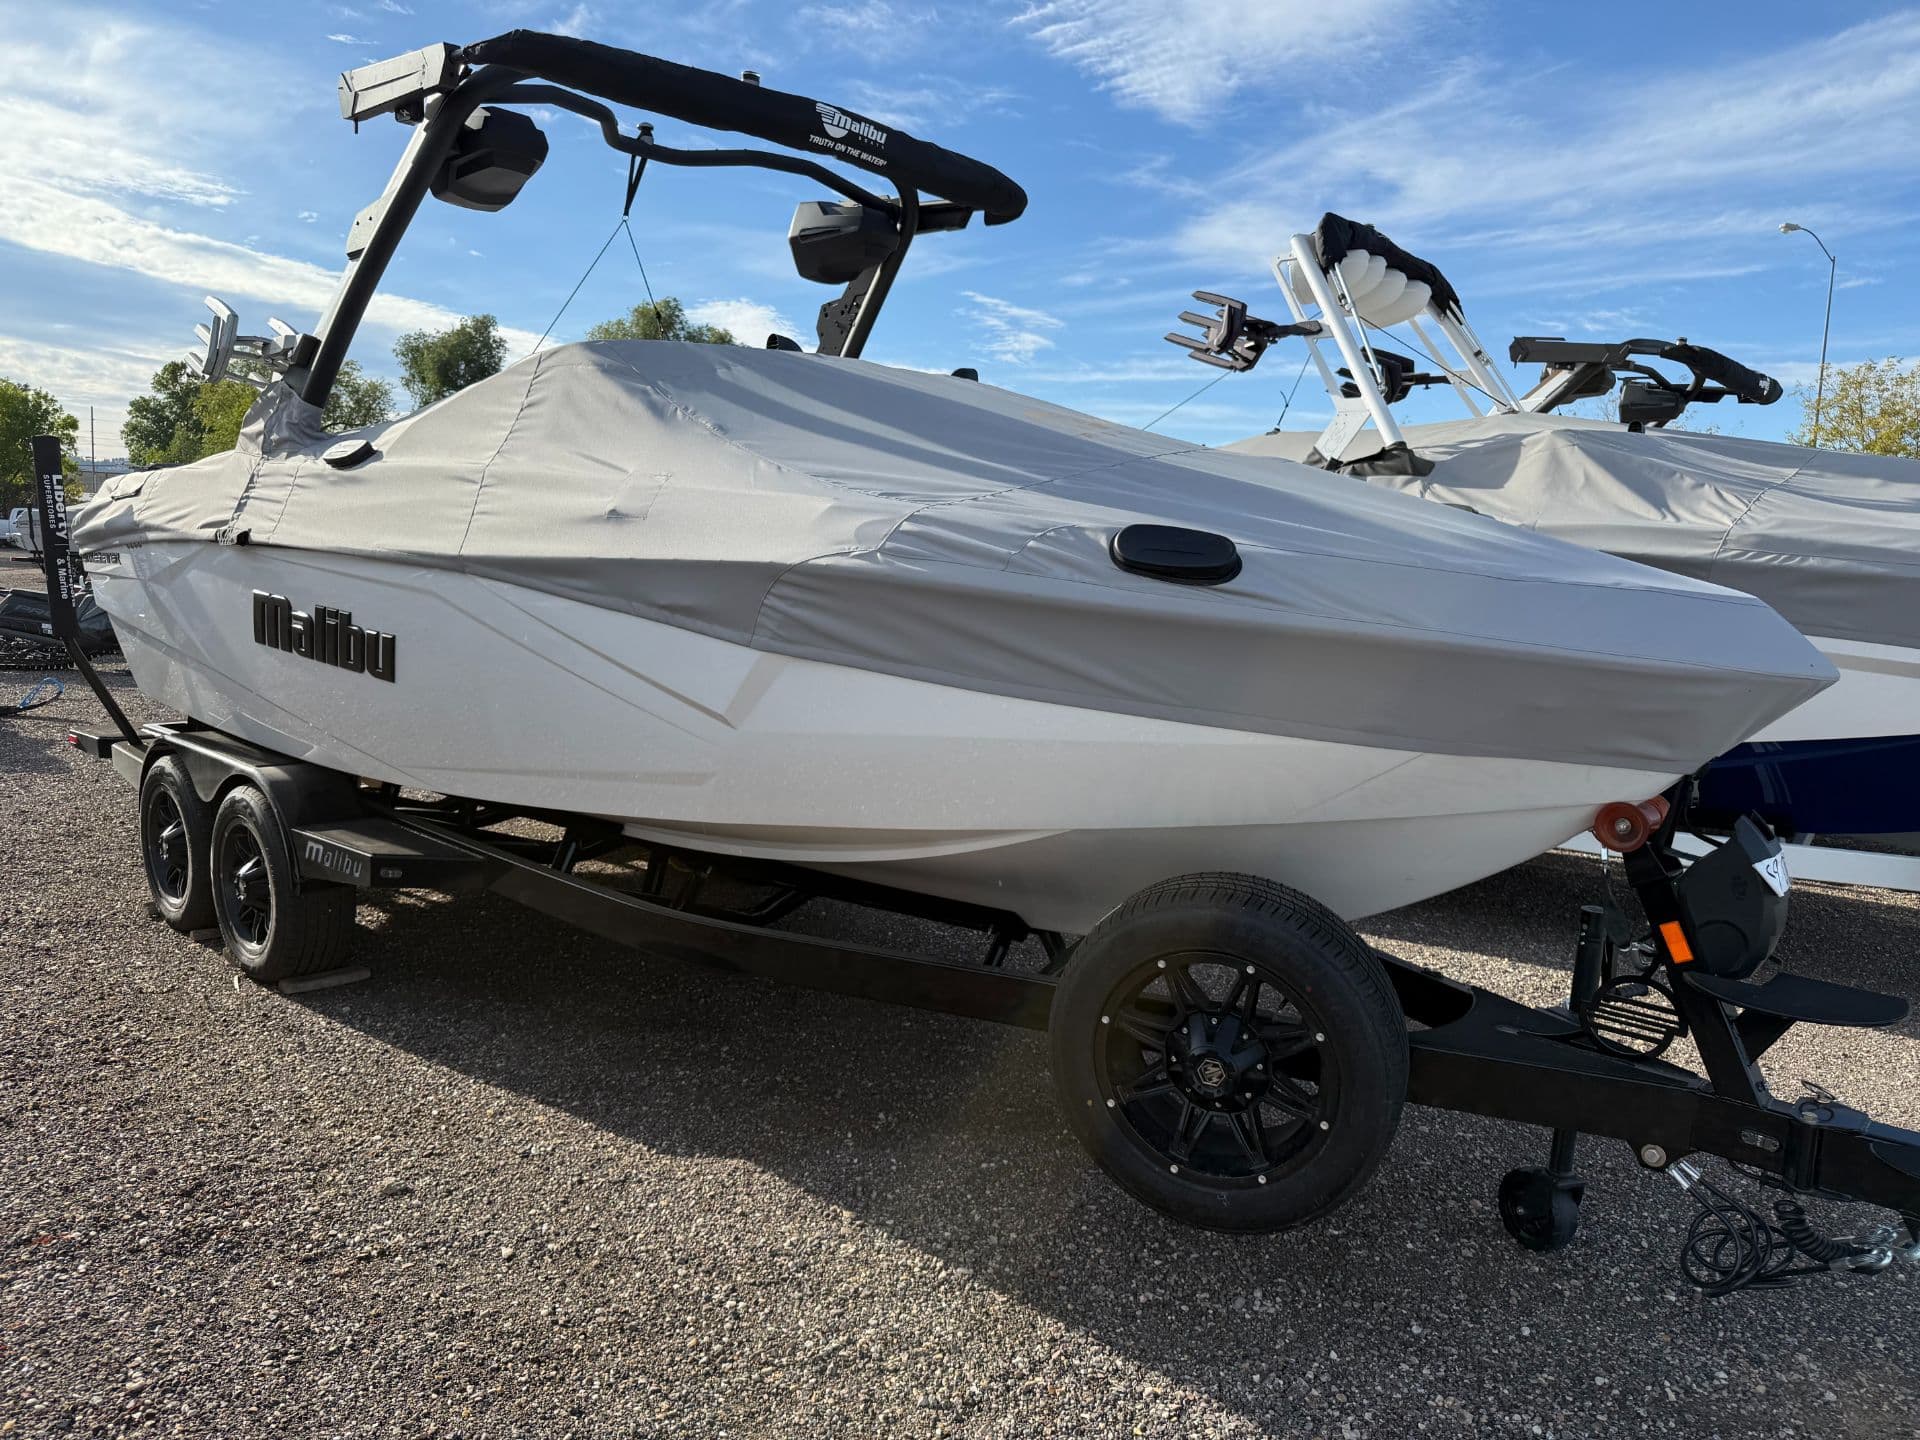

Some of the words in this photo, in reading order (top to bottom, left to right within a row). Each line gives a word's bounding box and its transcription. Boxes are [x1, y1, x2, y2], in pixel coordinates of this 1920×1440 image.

[832, 111, 888, 144] Malibu
[808, 134, 835, 149] TRUTH
[834, 142, 847, 153] ON
[846, 146, 861, 157] THE
[43, 474, 56, 529] SUPERSTORES
[52, 474, 68, 539] Liberty
[56, 558, 66, 566] &
[58, 568, 69, 600] Marine
[252, 589, 396, 683] Malibu
